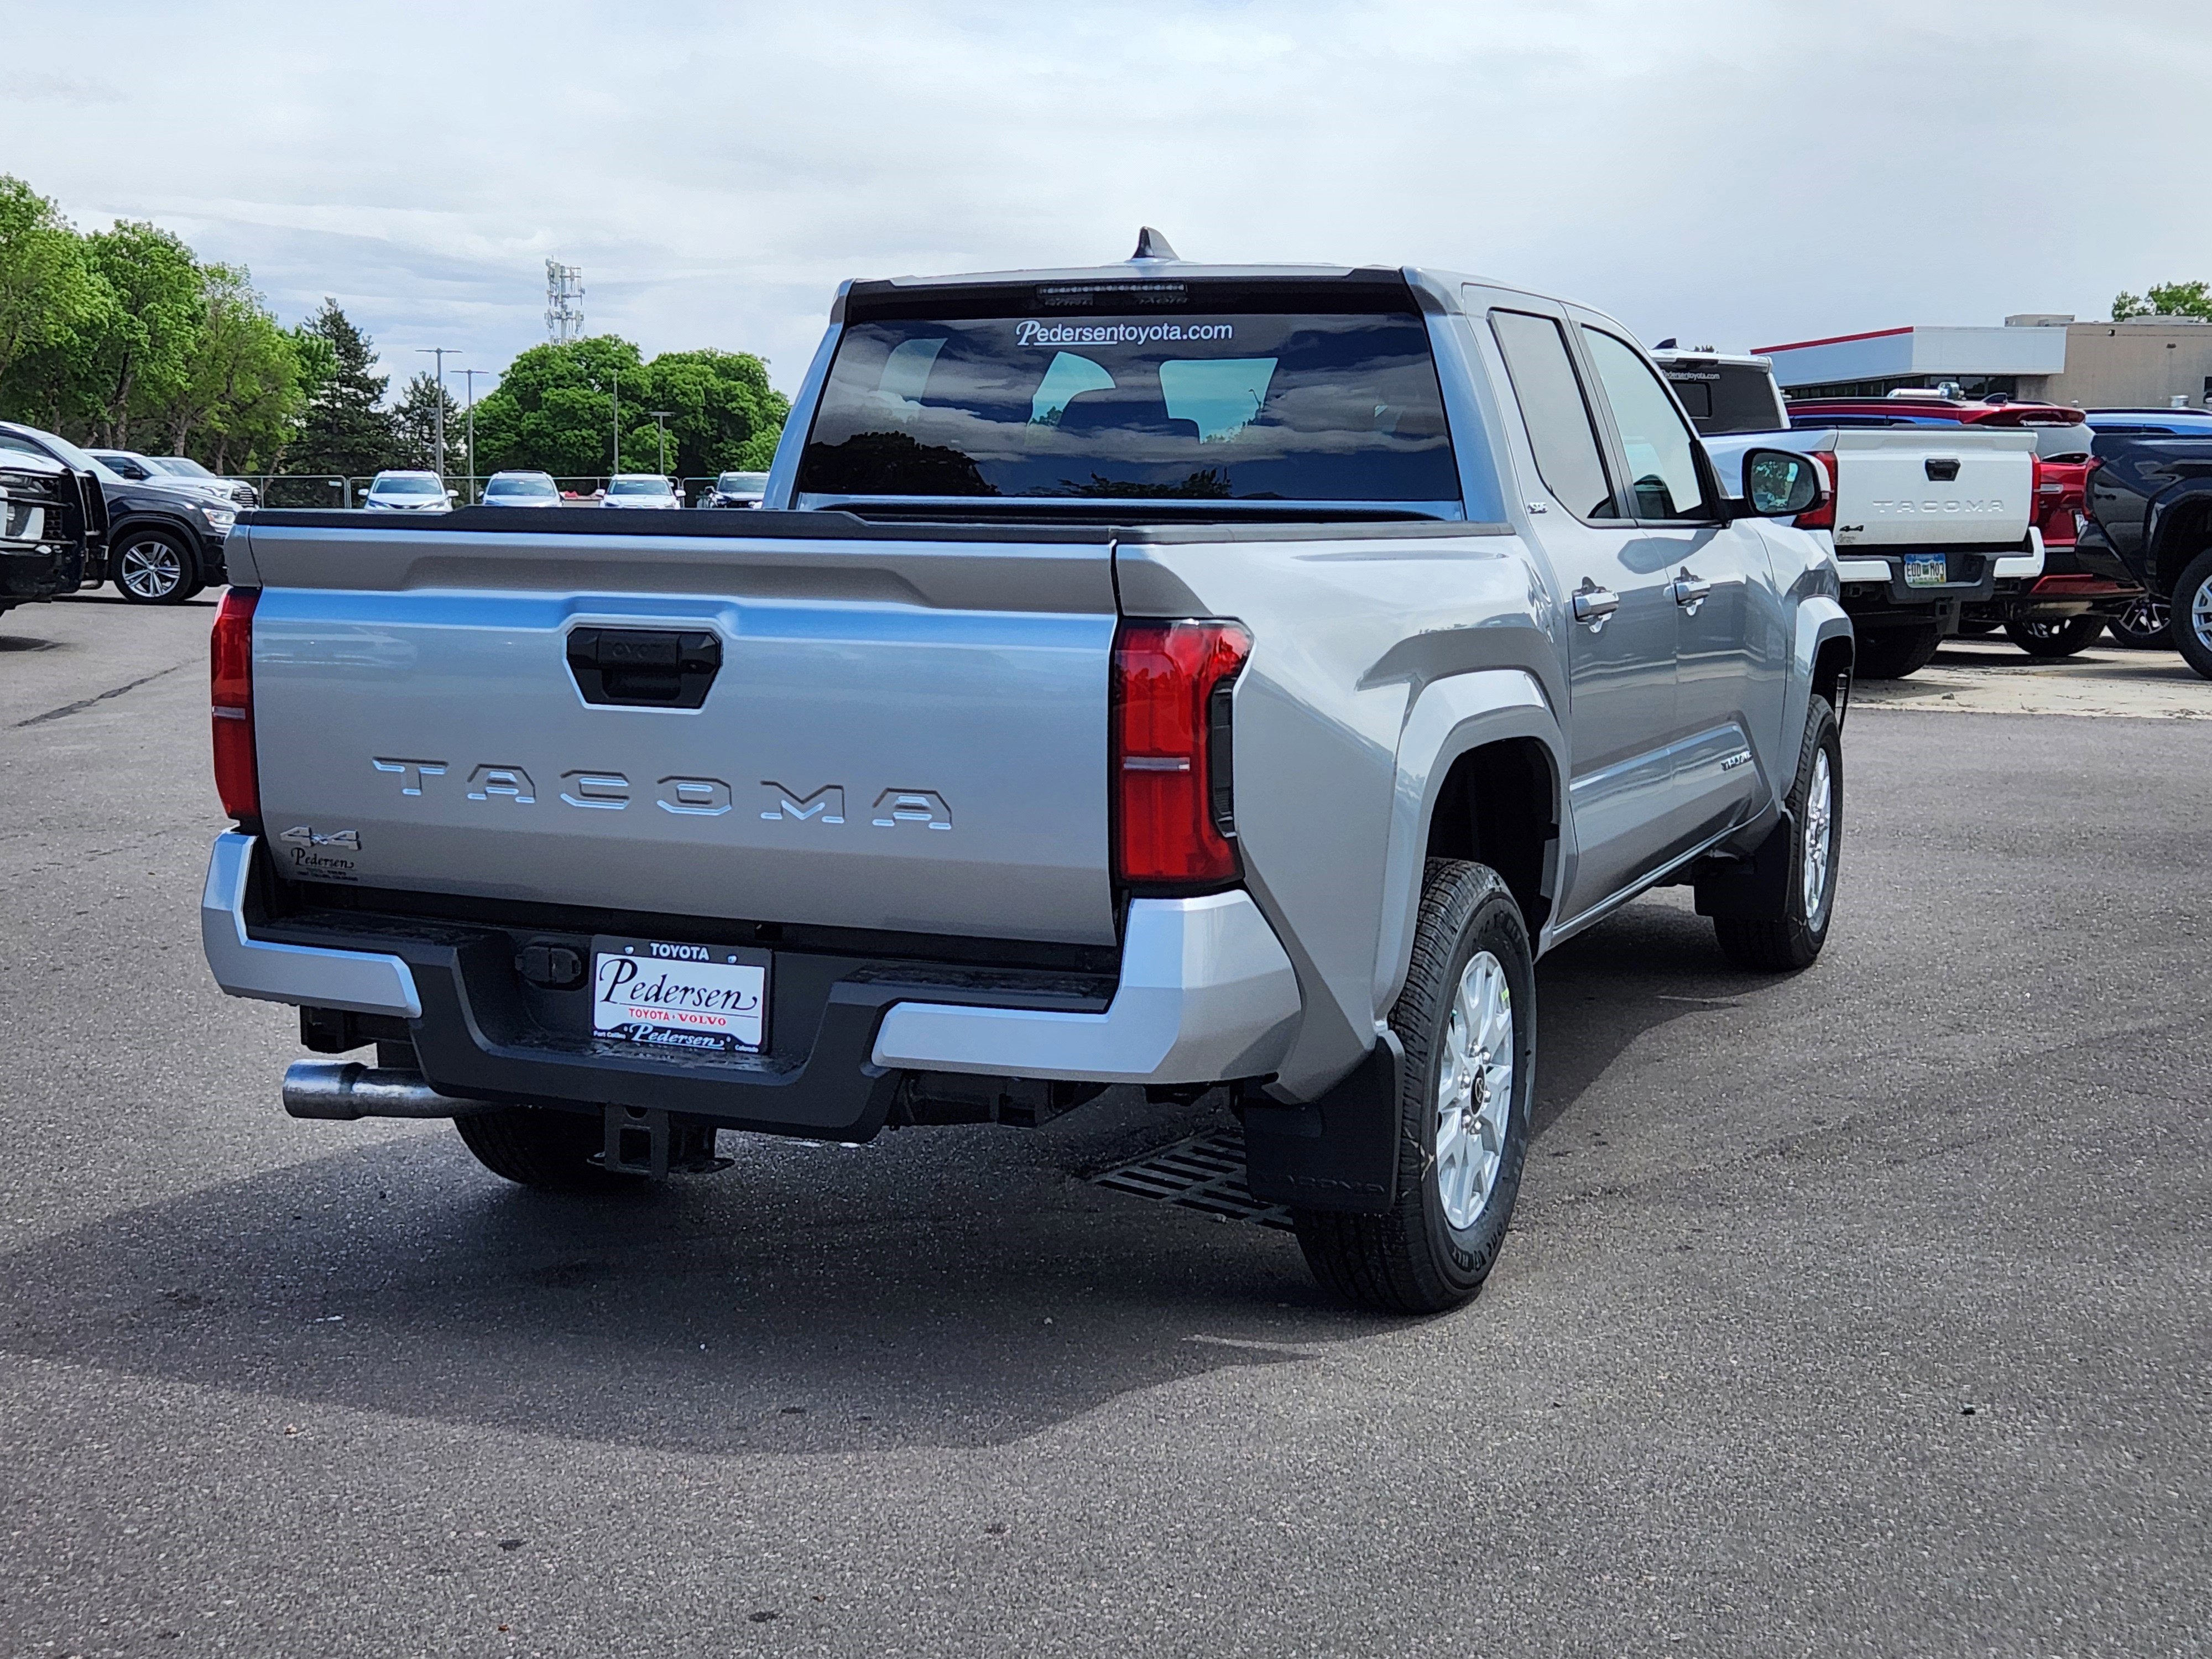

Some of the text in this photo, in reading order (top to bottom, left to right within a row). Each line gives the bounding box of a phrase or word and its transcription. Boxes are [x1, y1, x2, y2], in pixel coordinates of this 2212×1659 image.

[1016, 320, 1233, 346] Pedersentoyota.com
[1872, 500, 2004, 513] TACOMA
[372, 755, 952, 830] TACOMA
[290, 847, 354, 869] Pedersen
[649, 942, 709, 961] TOYOTA
[599, 958, 757, 1011] Pedersen
[629, 1008, 727, 1027] TOYOTA VOLVO
[629, 1022, 724, 1049] Pedersen
